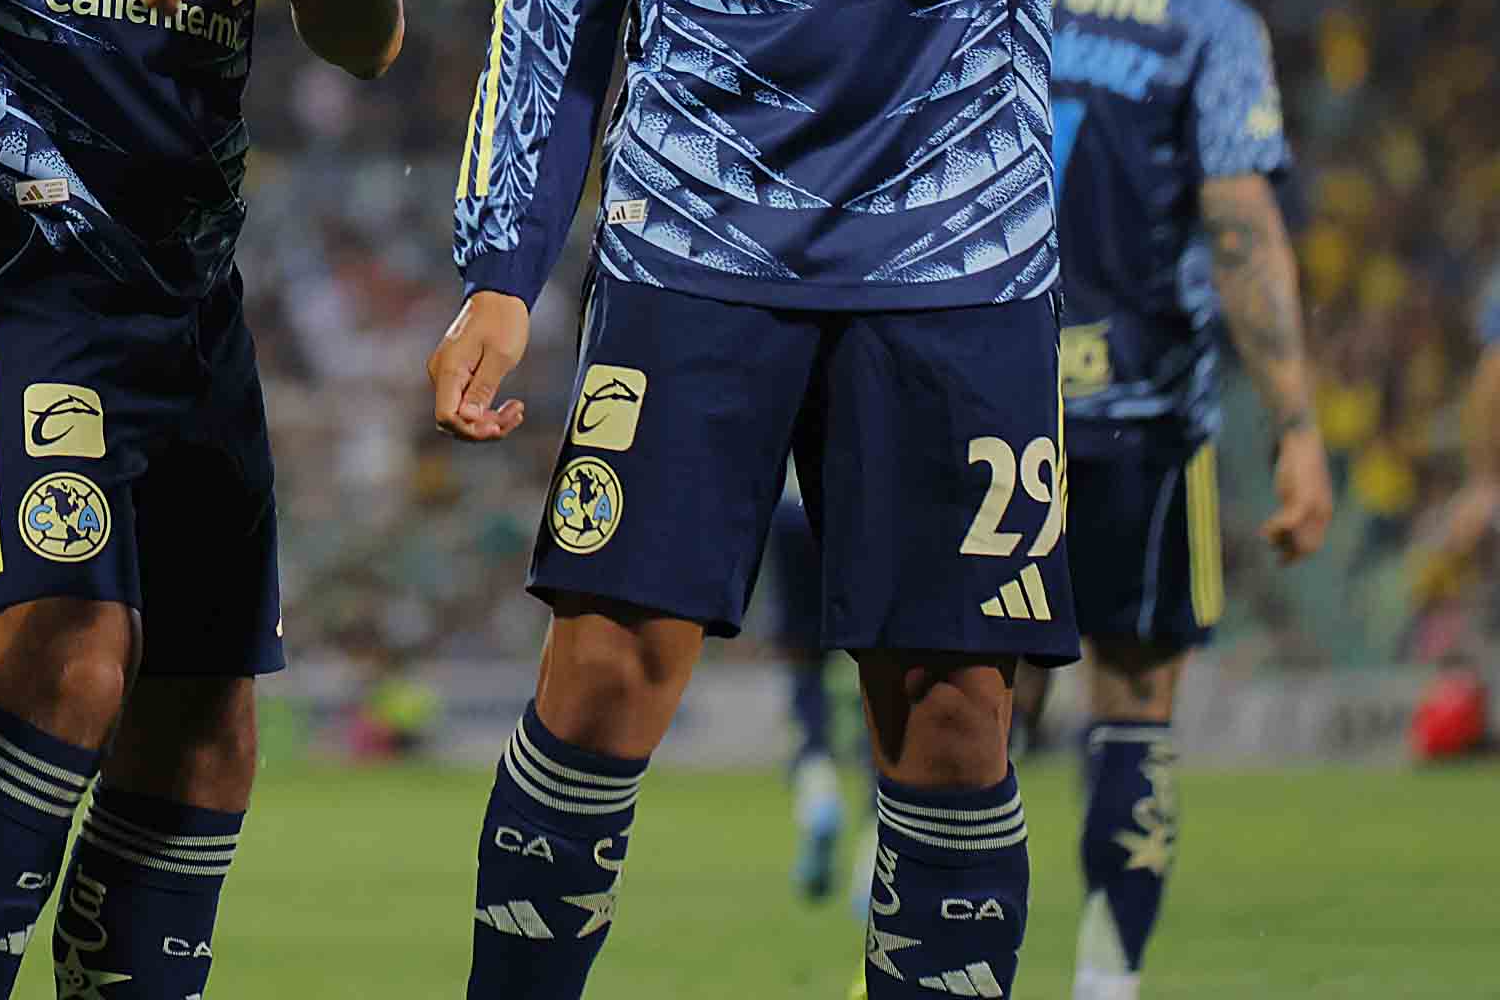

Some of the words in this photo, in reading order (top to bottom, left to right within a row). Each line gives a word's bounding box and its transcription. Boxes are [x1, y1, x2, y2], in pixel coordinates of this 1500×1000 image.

[959, 436, 1064, 557] 29
[494, 825, 554, 864] CA
[941, 897, 1005, 921] CA
[162, 935, 213, 959] CA
